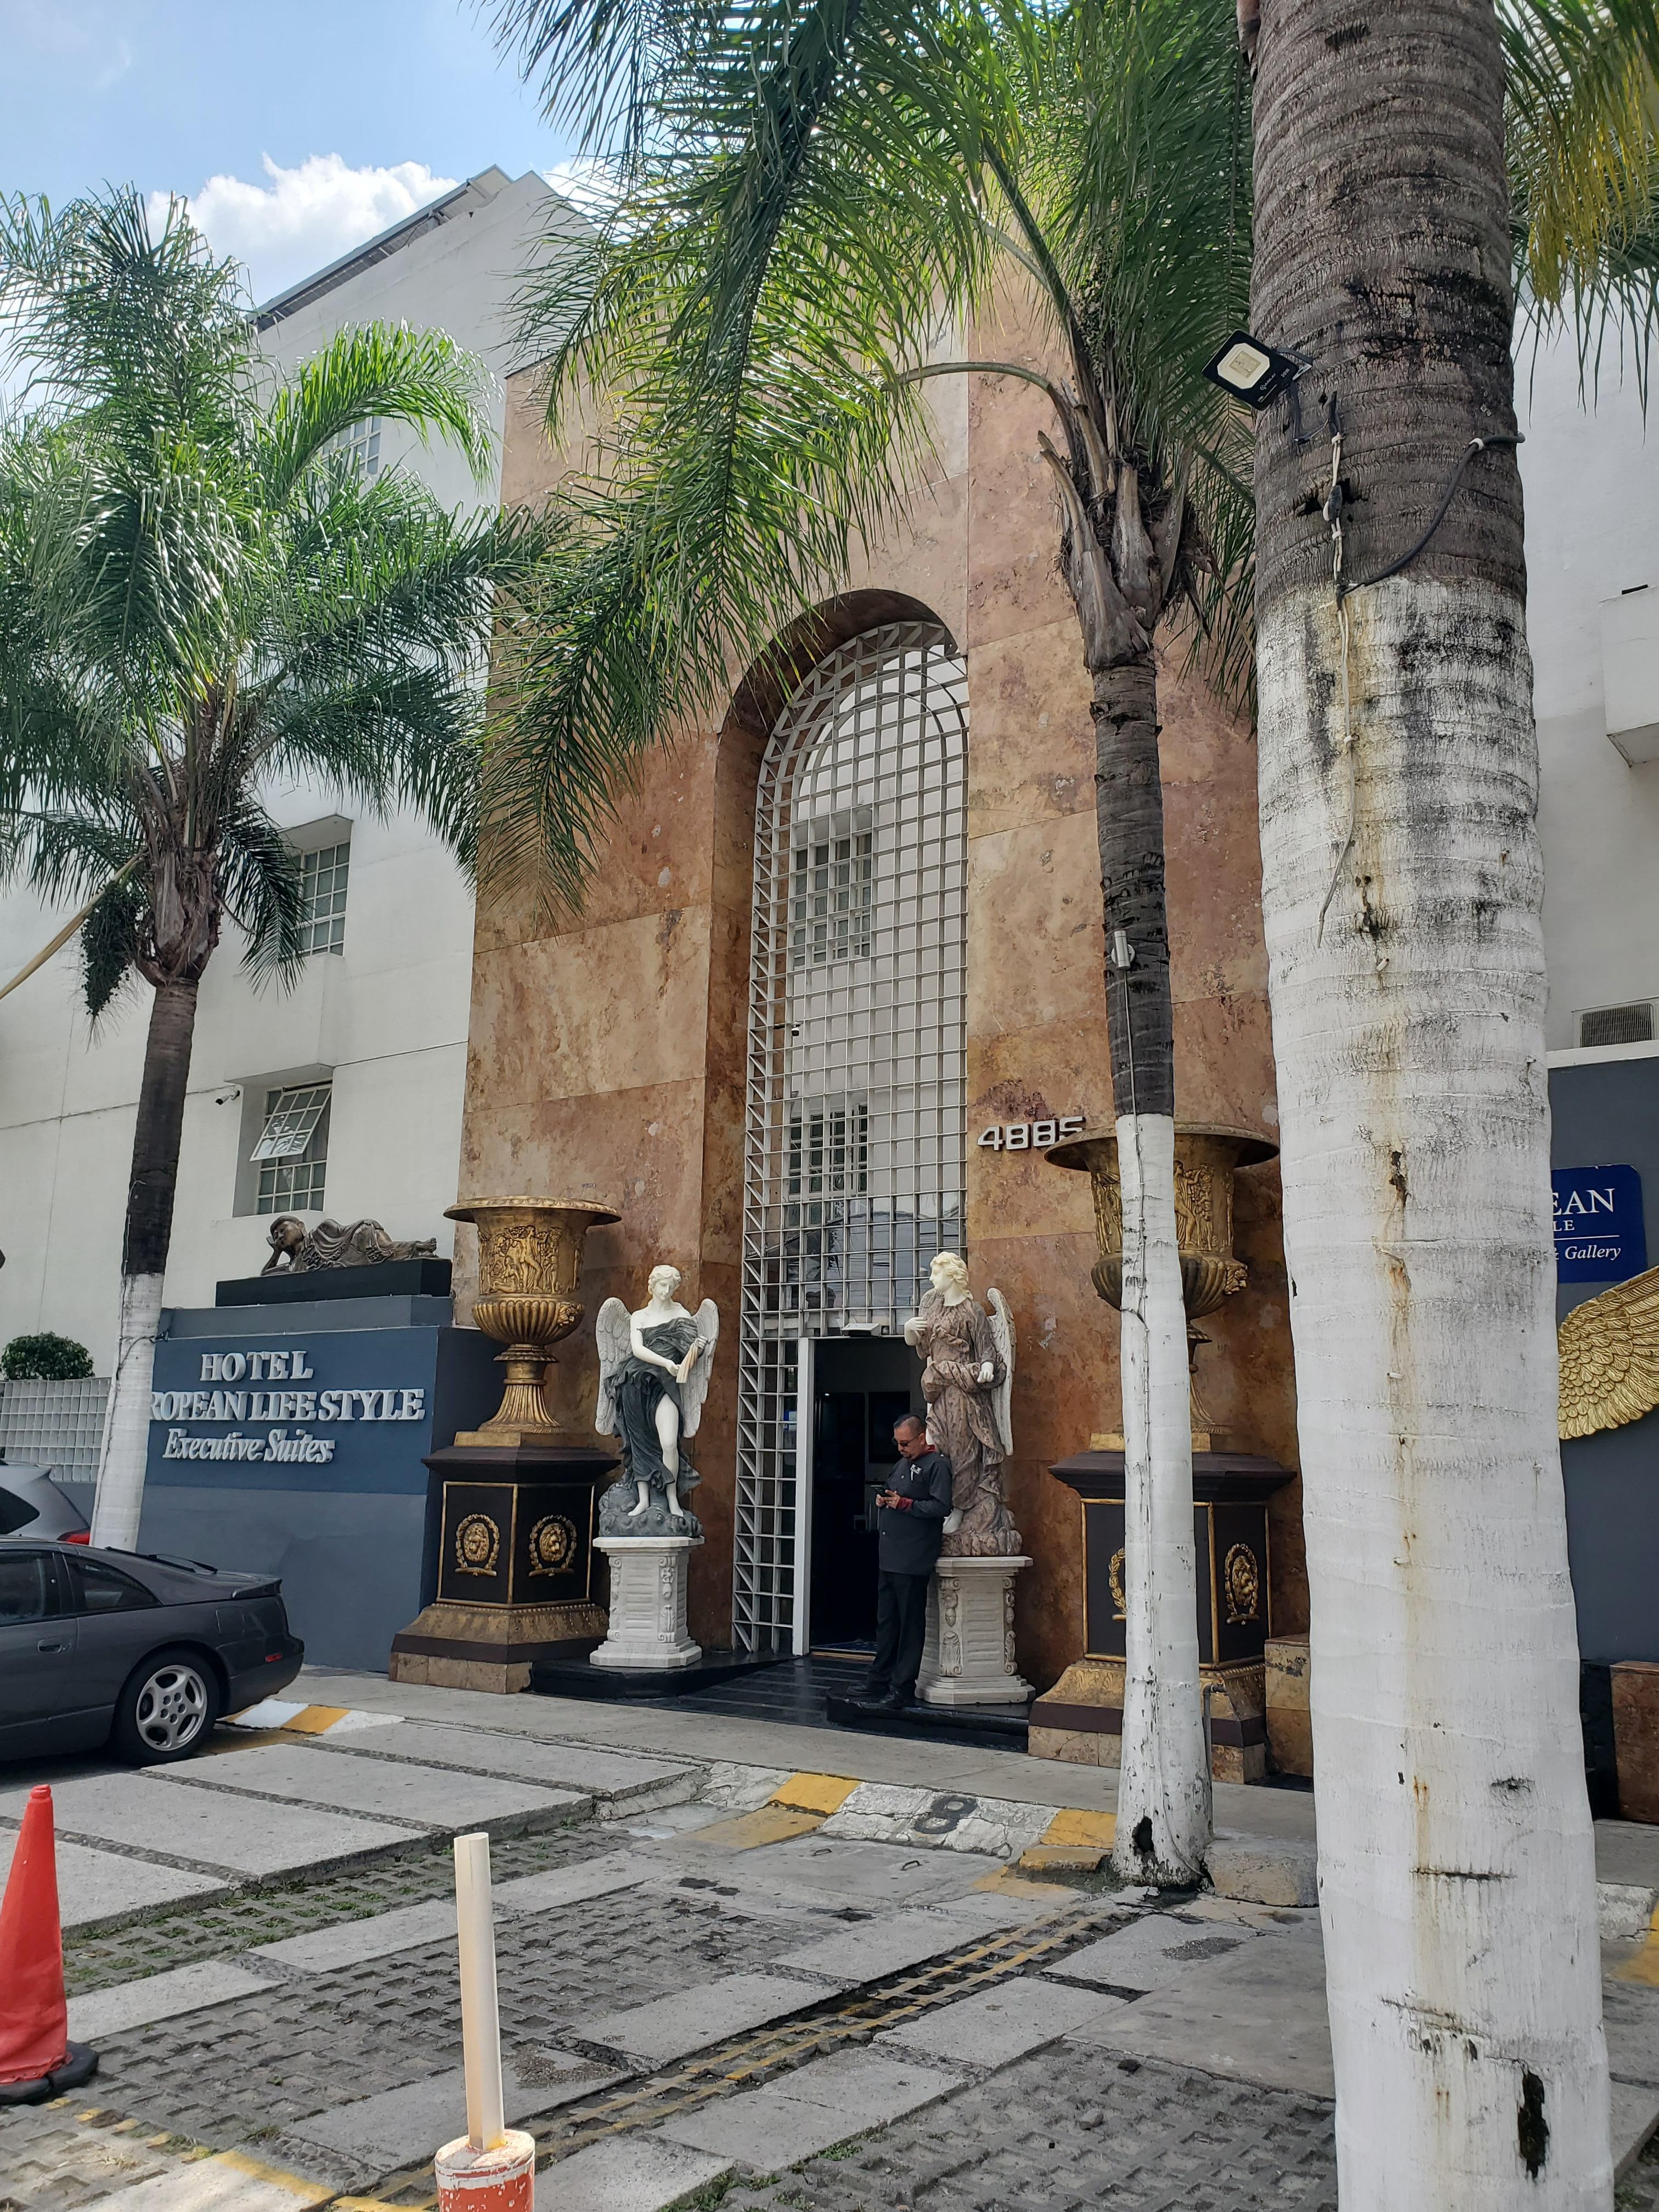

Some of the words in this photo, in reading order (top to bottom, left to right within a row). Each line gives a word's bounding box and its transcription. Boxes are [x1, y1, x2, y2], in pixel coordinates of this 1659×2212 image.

[977, 1115, 1086, 1151] 4885
[1565, 1244, 1621, 1261] Gallery
[200, 1351, 314, 1381] HOTEL
[162, 1428, 266, 1461] Executive
[263, 1429, 335, 1463] Suites
